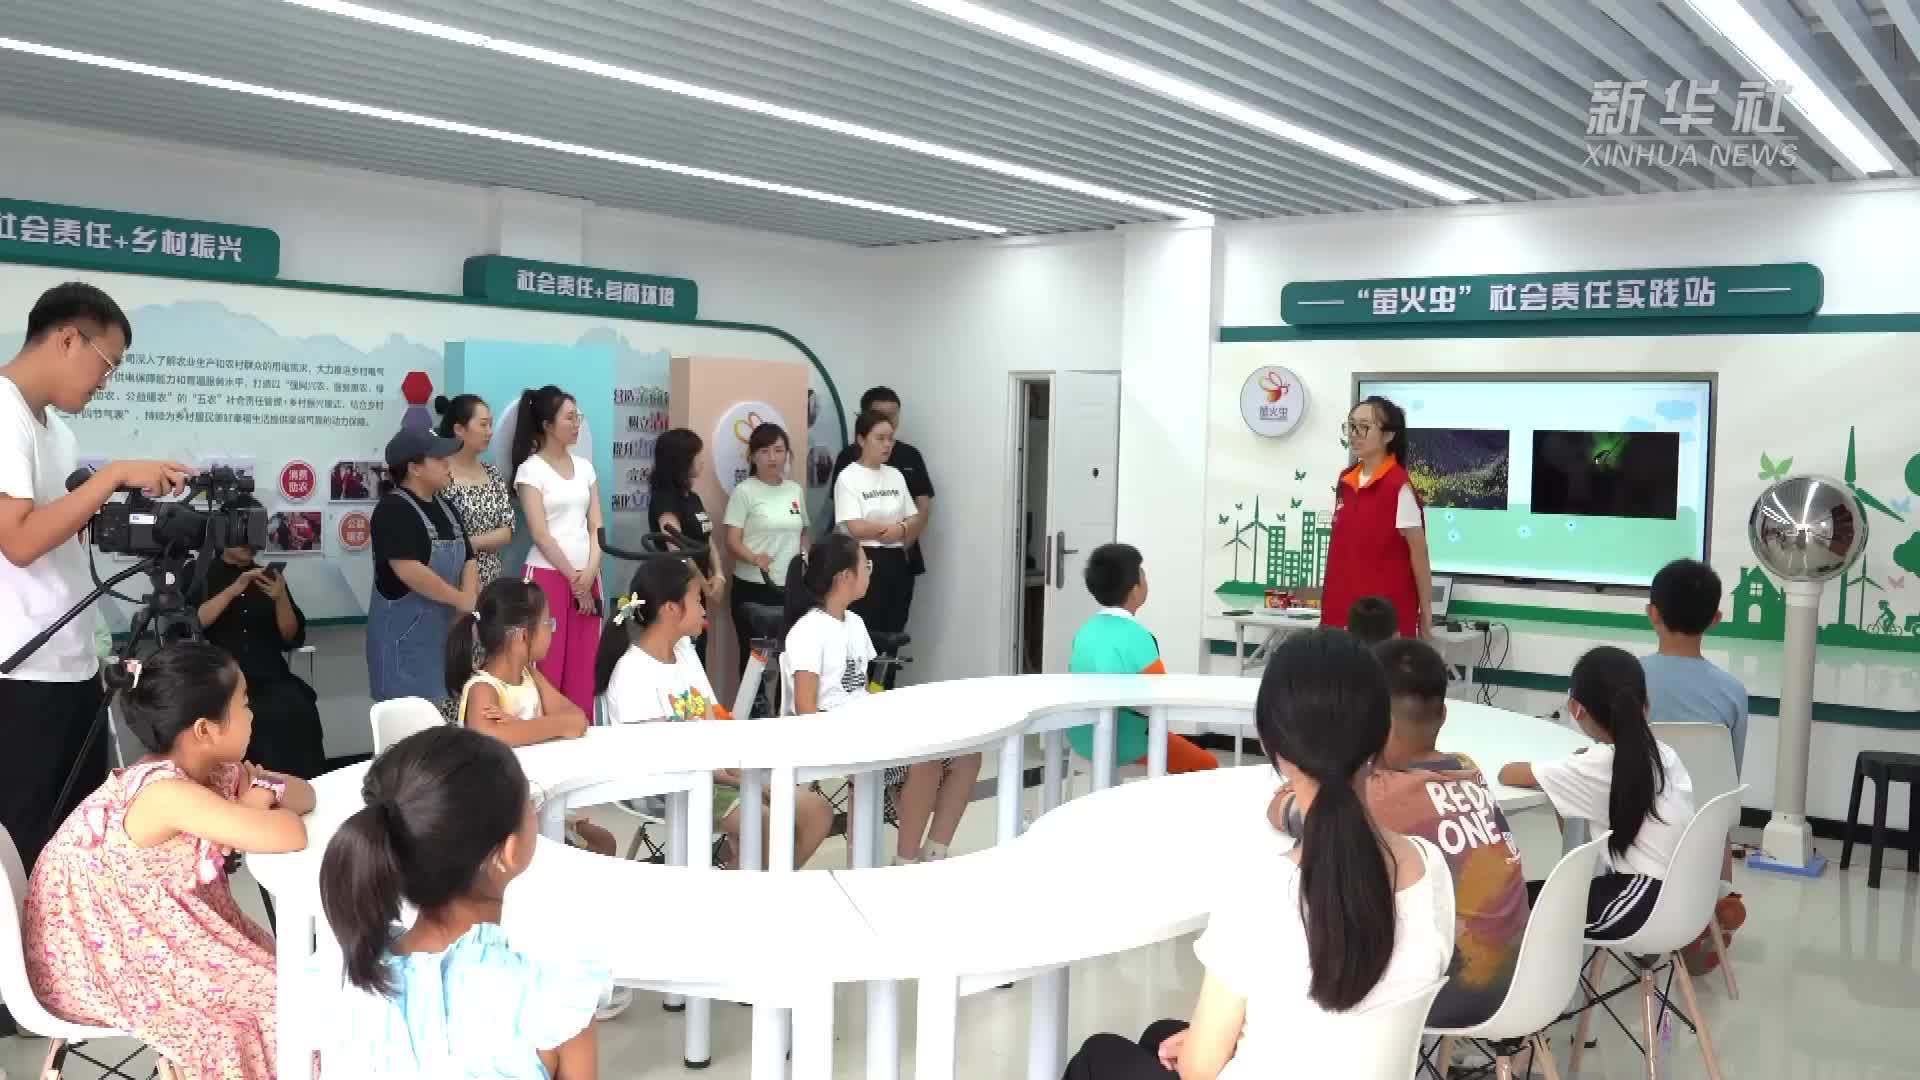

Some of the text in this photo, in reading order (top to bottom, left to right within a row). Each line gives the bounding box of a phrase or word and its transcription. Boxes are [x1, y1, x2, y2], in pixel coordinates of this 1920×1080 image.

[1489, 276, 1716, 312] 社会责任实践站
[1438, 808, 1502, 855] ONE
